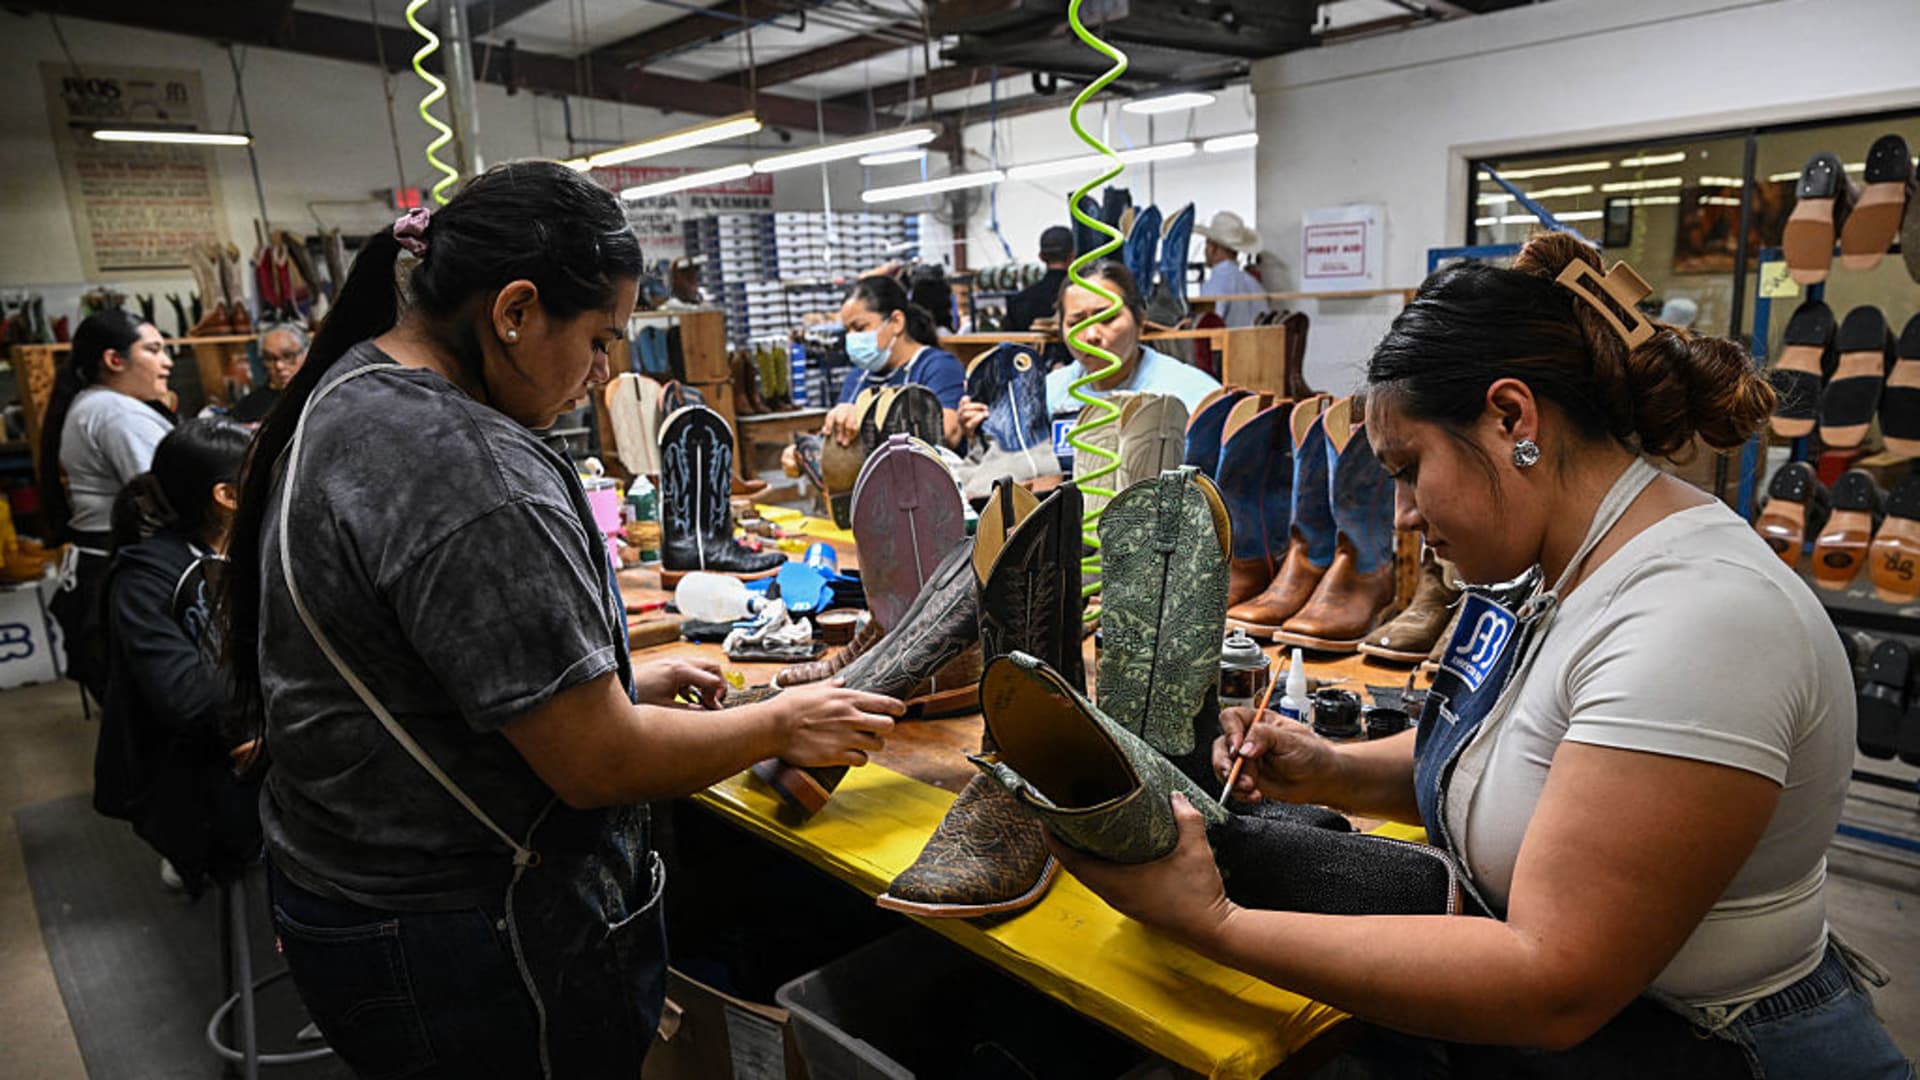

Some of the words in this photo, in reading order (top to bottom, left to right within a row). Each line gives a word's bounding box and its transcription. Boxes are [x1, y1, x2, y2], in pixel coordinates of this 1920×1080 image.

[690, 196, 771, 208] REMEMBER
[1307, 245, 1339, 254] FIRST
[1342, 243, 1362, 252] AID
